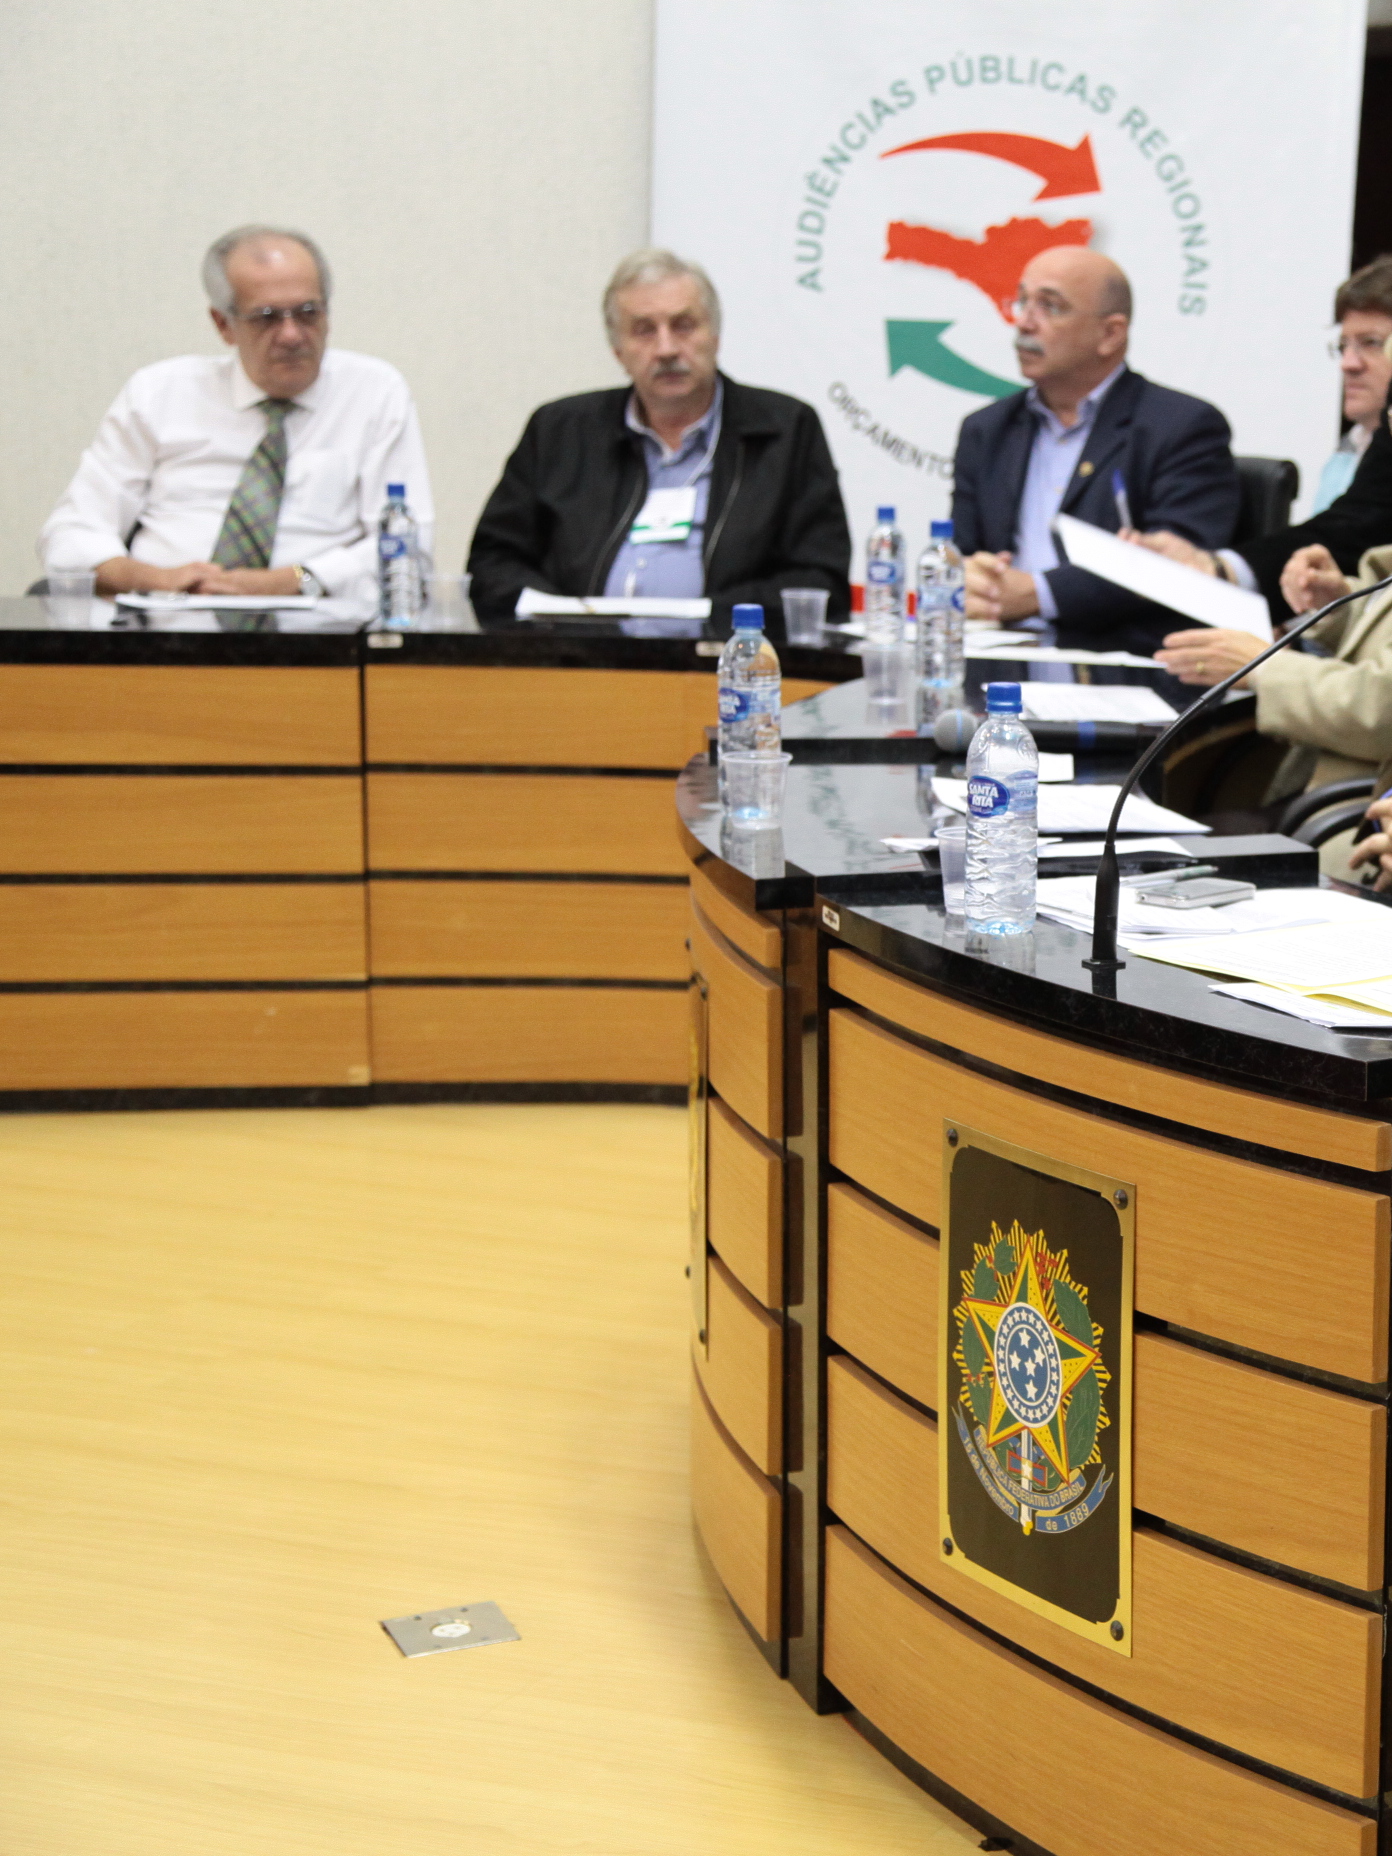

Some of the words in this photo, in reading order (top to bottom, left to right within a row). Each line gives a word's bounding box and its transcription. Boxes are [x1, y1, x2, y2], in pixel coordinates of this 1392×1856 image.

[795, 79, 917, 294] AUDIÊNCIAS
[923, 51, 1117, 115] PÚBLICAS
[1117, 105, 1210, 317] REGIONAIS
[969, 783, 999, 798] SANTA
[972, 794, 994, 808] RITA
[969, 1453, 981, 1470] de
[1045, 1518, 1058, 1531] de
[1064, 1502, 1090, 1528] 1889
[1007, 1482, 1050, 1508] FEDERATIVA
[1050, 1493, 1060, 1506] DO
[1059, 1482, 1085, 1504] BRASIL
